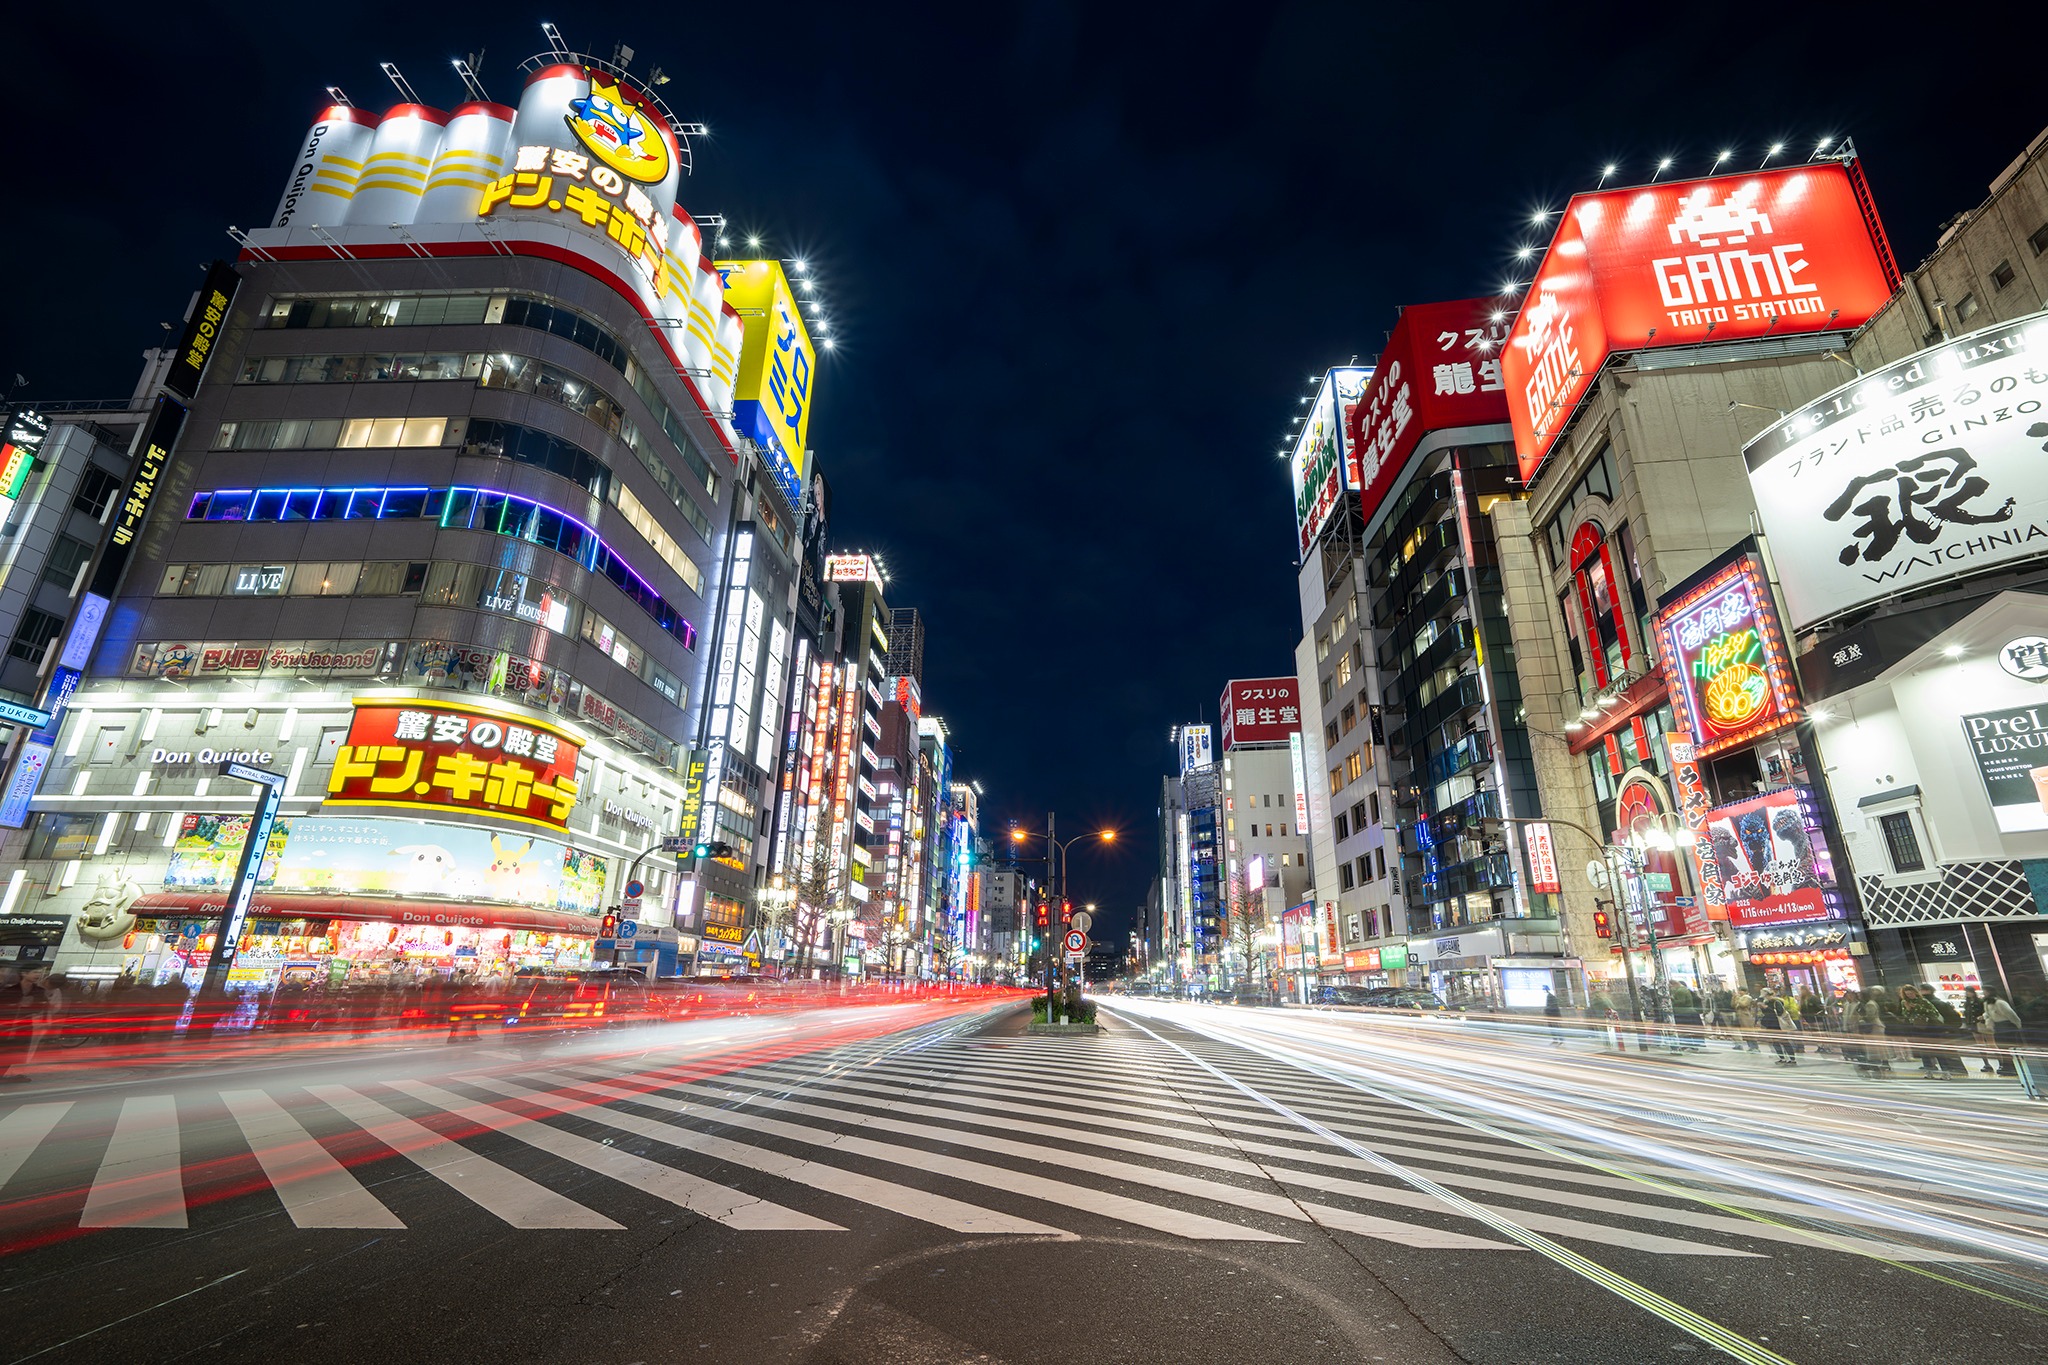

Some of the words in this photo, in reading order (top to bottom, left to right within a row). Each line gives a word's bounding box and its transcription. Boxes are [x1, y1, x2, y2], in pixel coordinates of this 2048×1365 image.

[304, 125, 328, 158] Don
[278, 163, 314, 227] Quijote
[1651, 243, 1818, 308] GAME
[1666, 304, 1729, 328] TAITO
[1736, 296, 1826, 321] STATION
[186, 289, 228, 370] 驚安の殿堂
[1525, 310, 1579, 429] GAME
[1361, 360, 1401, 440] クスリの
[1362, 381, 1413, 491] 龍生堂
[1788, 367, 2048, 478] ブランド品売るのも
[1921, 400, 2042, 444] GINZO
[1297, 427, 1337, 527] SUNPARK
[1823, 432, 2048, 567] 銀
[1862, 520, 2048, 584] WATCHNIA
[236, 572, 282, 590] LIVE
[484, 594, 512, 611] LIVE
[516, 602, 548, 622] HOUSE
[201, 648, 265, 669] 면세점
[269, 648, 376, 669] ร้านปลอดภาษี
[457, 649, 494, 664] Tax
[720, 617, 737, 701] KIBORI
[1832, 643, 1863, 666] 銀蔵
[473, 663, 531, 690] Sop
[1240, 688, 1289, 700] クスリの
[1235, 706, 1299, 726] 龍生堂
[394, 709, 560, 765] 驚安の殿堂
[150, 748, 191, 764] Don
[198, 747, 273, 766] Quijote
[1984, 757, 2019, 766] HERMES
[1986, 766, 2005, 774] LOUIS
[2004, 763, 2033, 773] VUITTON
[230, 765, 259, 780] CENTRAL
[259, 774, 277, 784] ROAD
[1989, 773, 2024, 781] CHANEL
[1678, 765, 1706, 830] ラーメン
[604, 798, 624, 817] Don
[624, 806, 654, 828] Quijote
[234, 811, 274, 921] ゴジラロード
[1731, 871, 1760, 889] ゴジラ
[200, 903, 225, 913] Don
[402, 912, 433, 923] Don
[434, 913, 484, 926] Quijote
[568, 923, 580, 932] Don
[581, 924, 601, 936] Quijot
